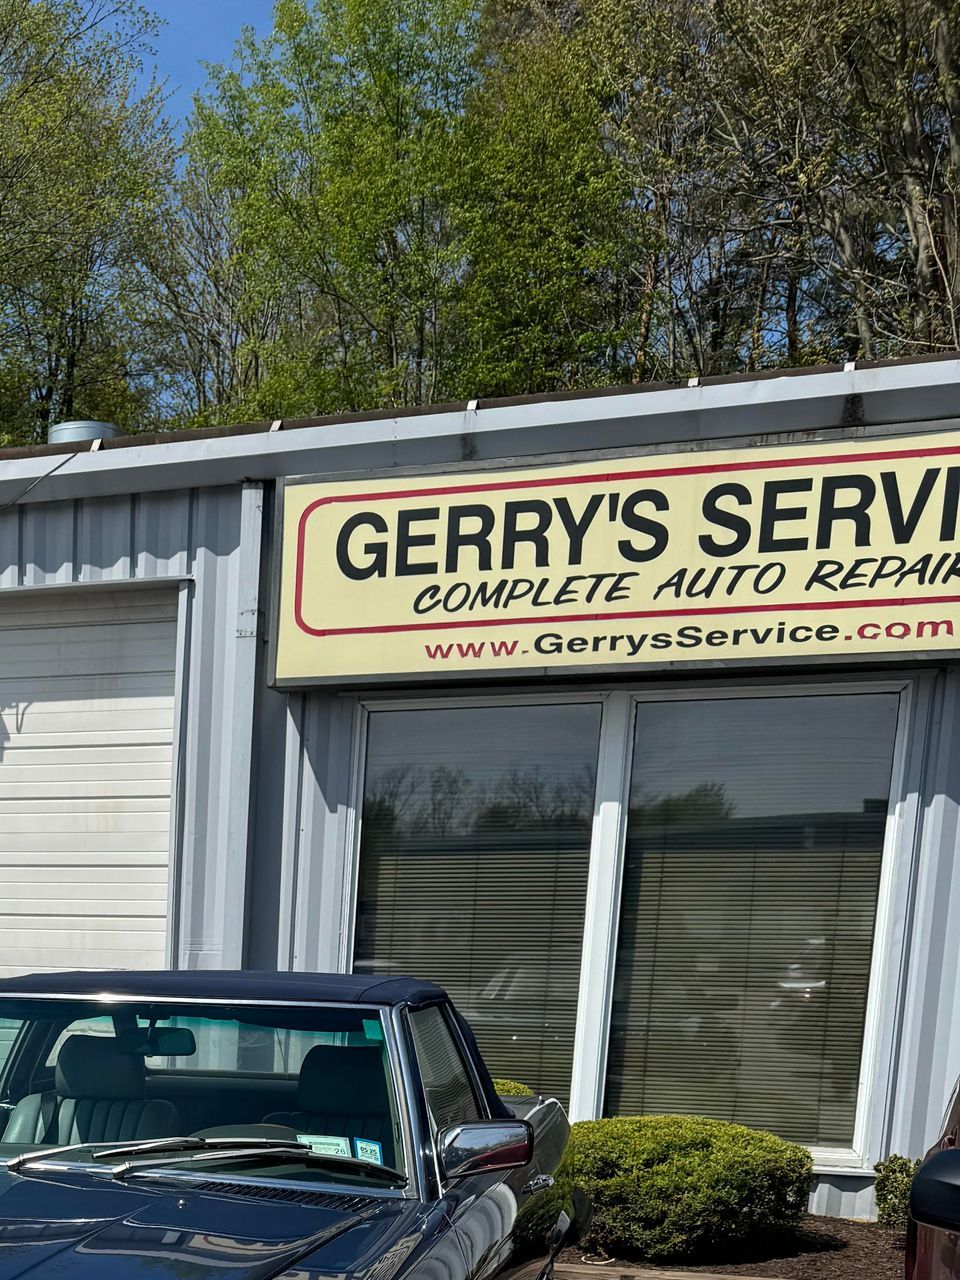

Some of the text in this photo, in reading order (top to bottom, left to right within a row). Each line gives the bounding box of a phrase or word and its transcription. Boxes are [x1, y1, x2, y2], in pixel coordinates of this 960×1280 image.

[336, 466, 960, 580] GERRY'S SERVI
[413, 571, 640, 614] COMPLETE
[653, 562, 786, 600] AUTO
[424, 619, 954, 659] www.GerrysService.com
